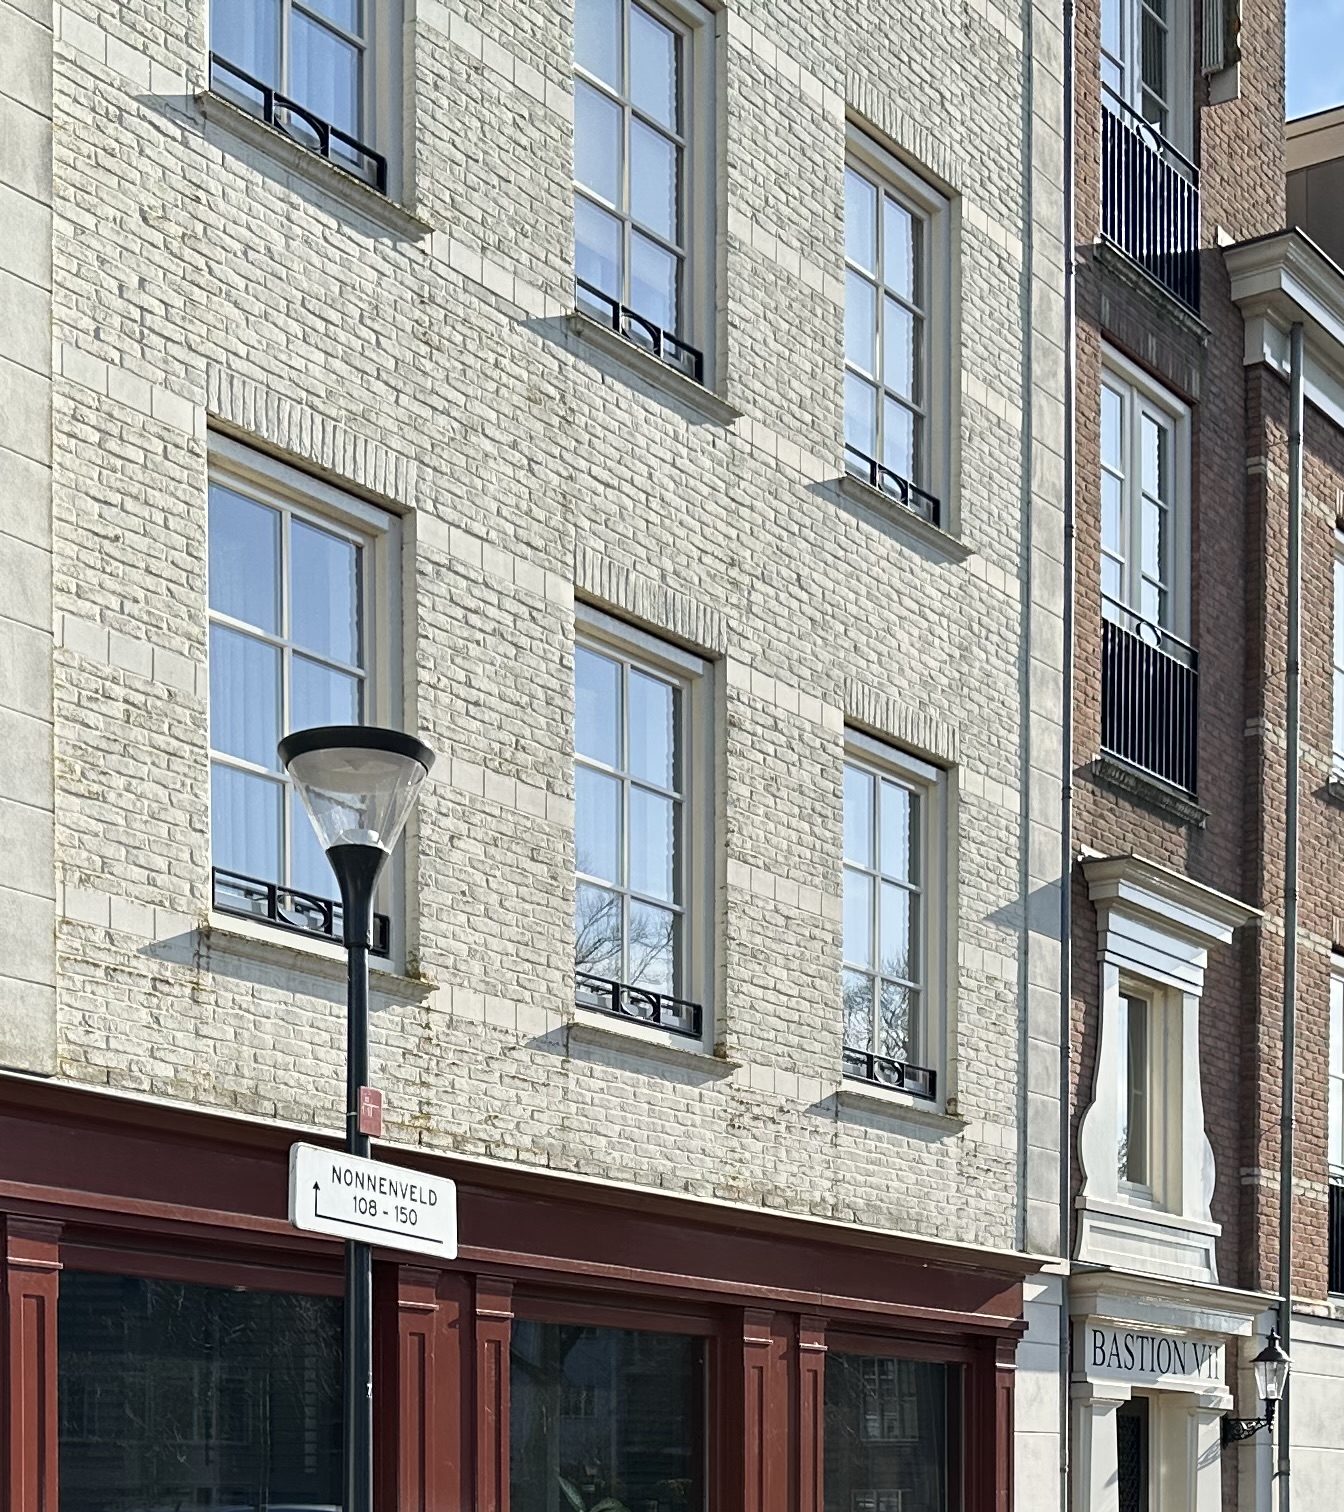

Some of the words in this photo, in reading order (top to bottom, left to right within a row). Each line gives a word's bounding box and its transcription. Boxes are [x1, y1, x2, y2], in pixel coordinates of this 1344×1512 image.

[332, 1165, 437, 1206] NONNENVELD
[353, 1196, 377, 1217] 108
[395, 1205, 418, 1226] 150
[1092, 1329, 1187, 1376] BASTION
[1192, 1342, 1220, 1380] VII
